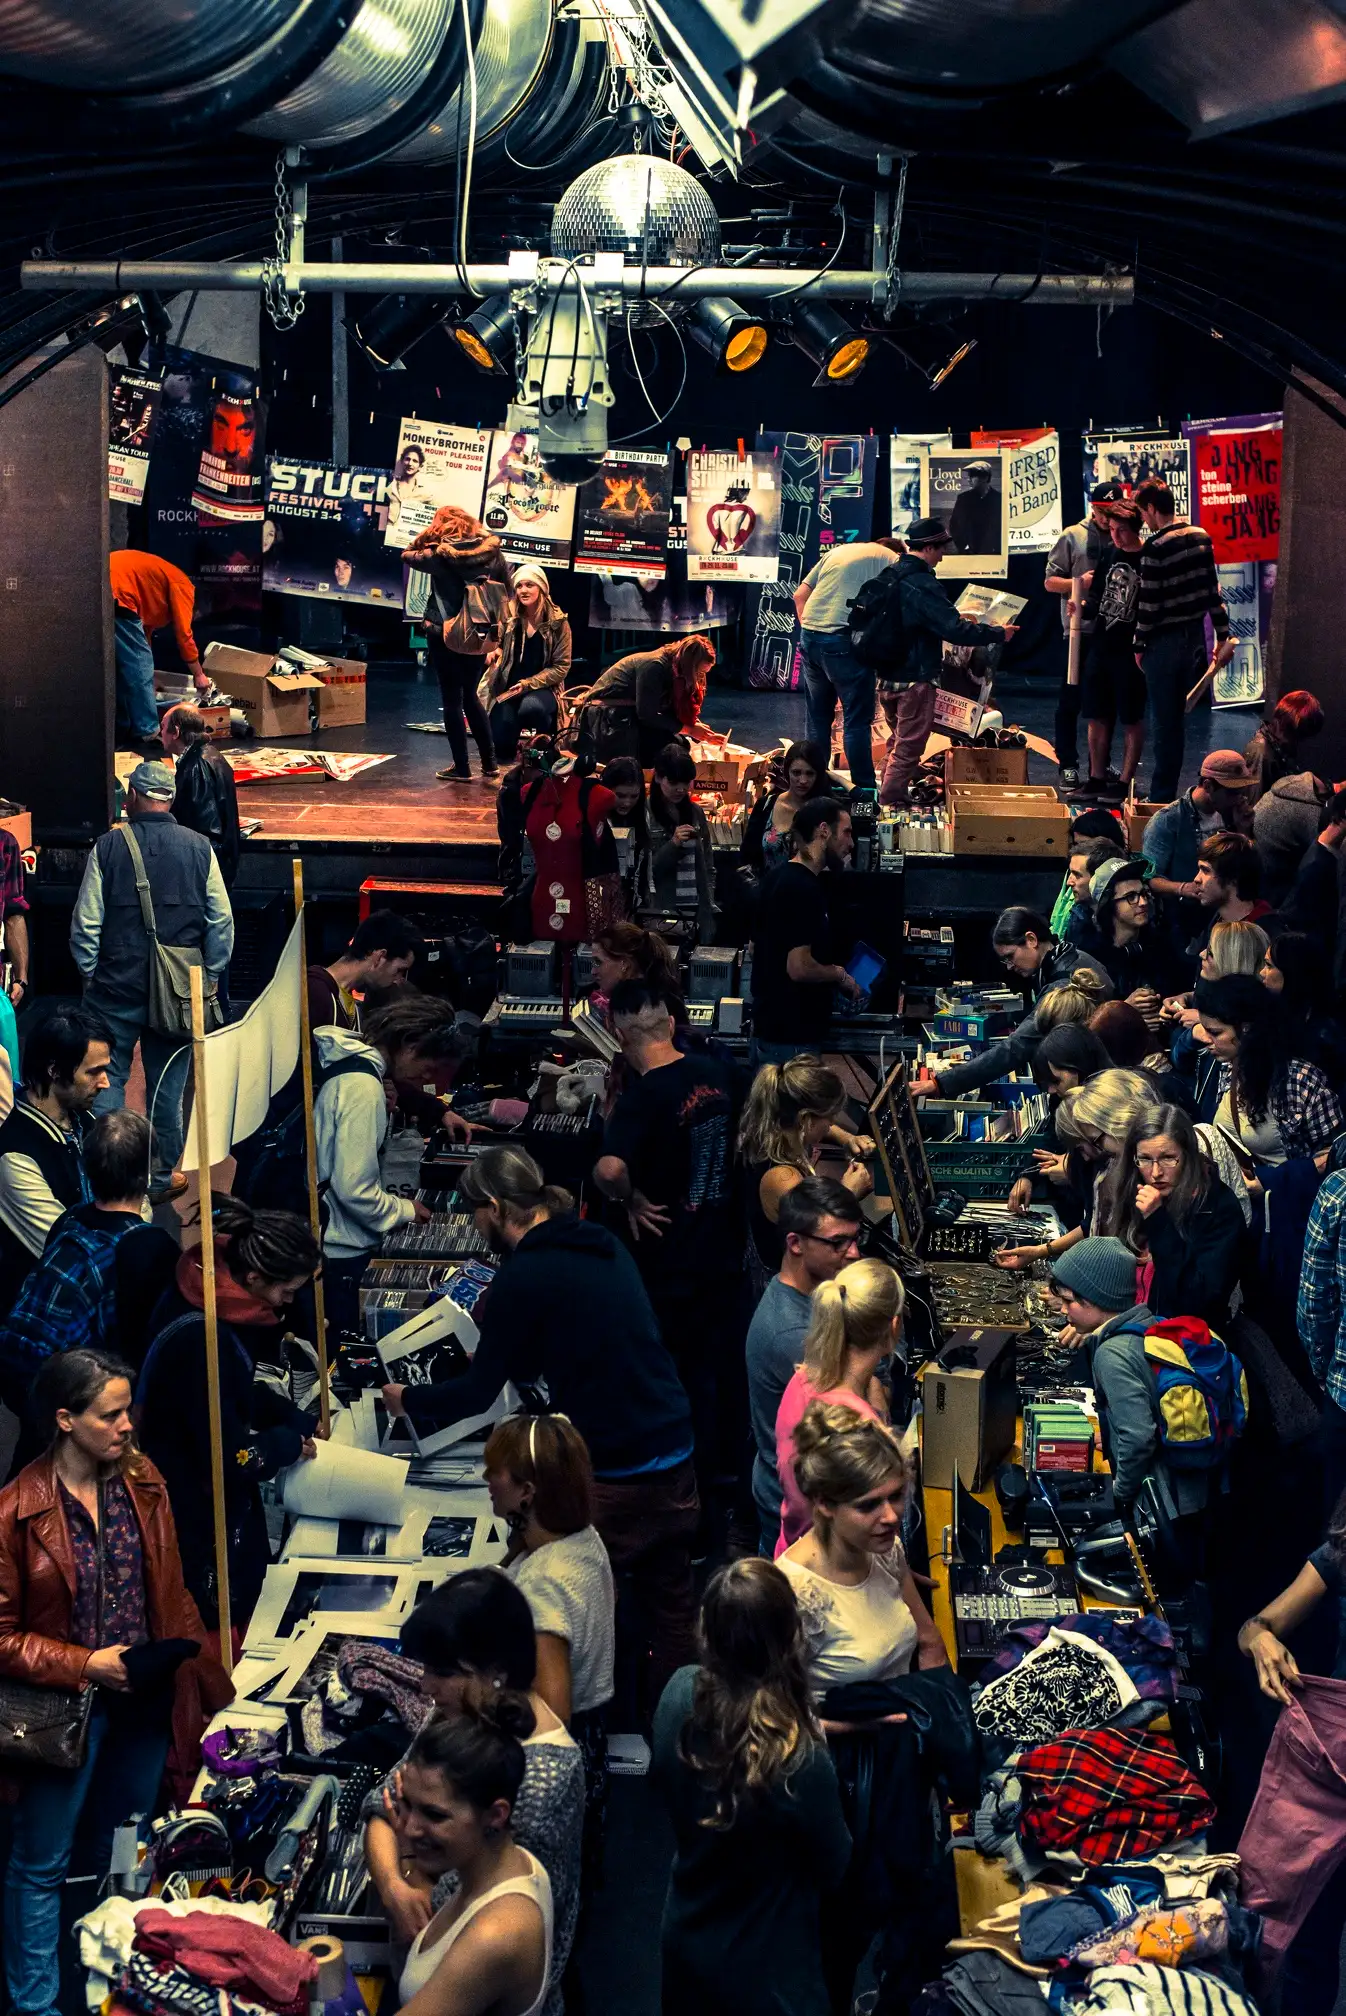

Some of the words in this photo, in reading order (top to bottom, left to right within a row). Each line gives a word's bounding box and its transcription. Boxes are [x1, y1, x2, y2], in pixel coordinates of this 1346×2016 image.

[403, 432, 485, 453] MONEYBROTHER
[424, 447, 447, 457] MOUNT
[450, 451, 484, 462] PLEASURE
[614, 451, 643, 462] BIRTHDAY
[645, 454, 666, 463] PARTY
[445, 461, 463, 470] TOUR
[929, 467, 962, 484] Lloyd
[1165, 470, 1187, 486] TON
[1201, 469, 1217, 480] ton
[271, 463, 394, 503] STUCK
[934, 479, 962, 491] Cole
[1202, 482, 1231, 494] steine
[269, 491, 342, 511] FESTIVAL
[1023, 484, 1058, 513] Band
[1202, 494, 1248, 507] scherben
[268, 504, 319, 519] AUGUST
[320, 511, 342, 522] 3-4
[695, 781, 726, 790] ANGELO
